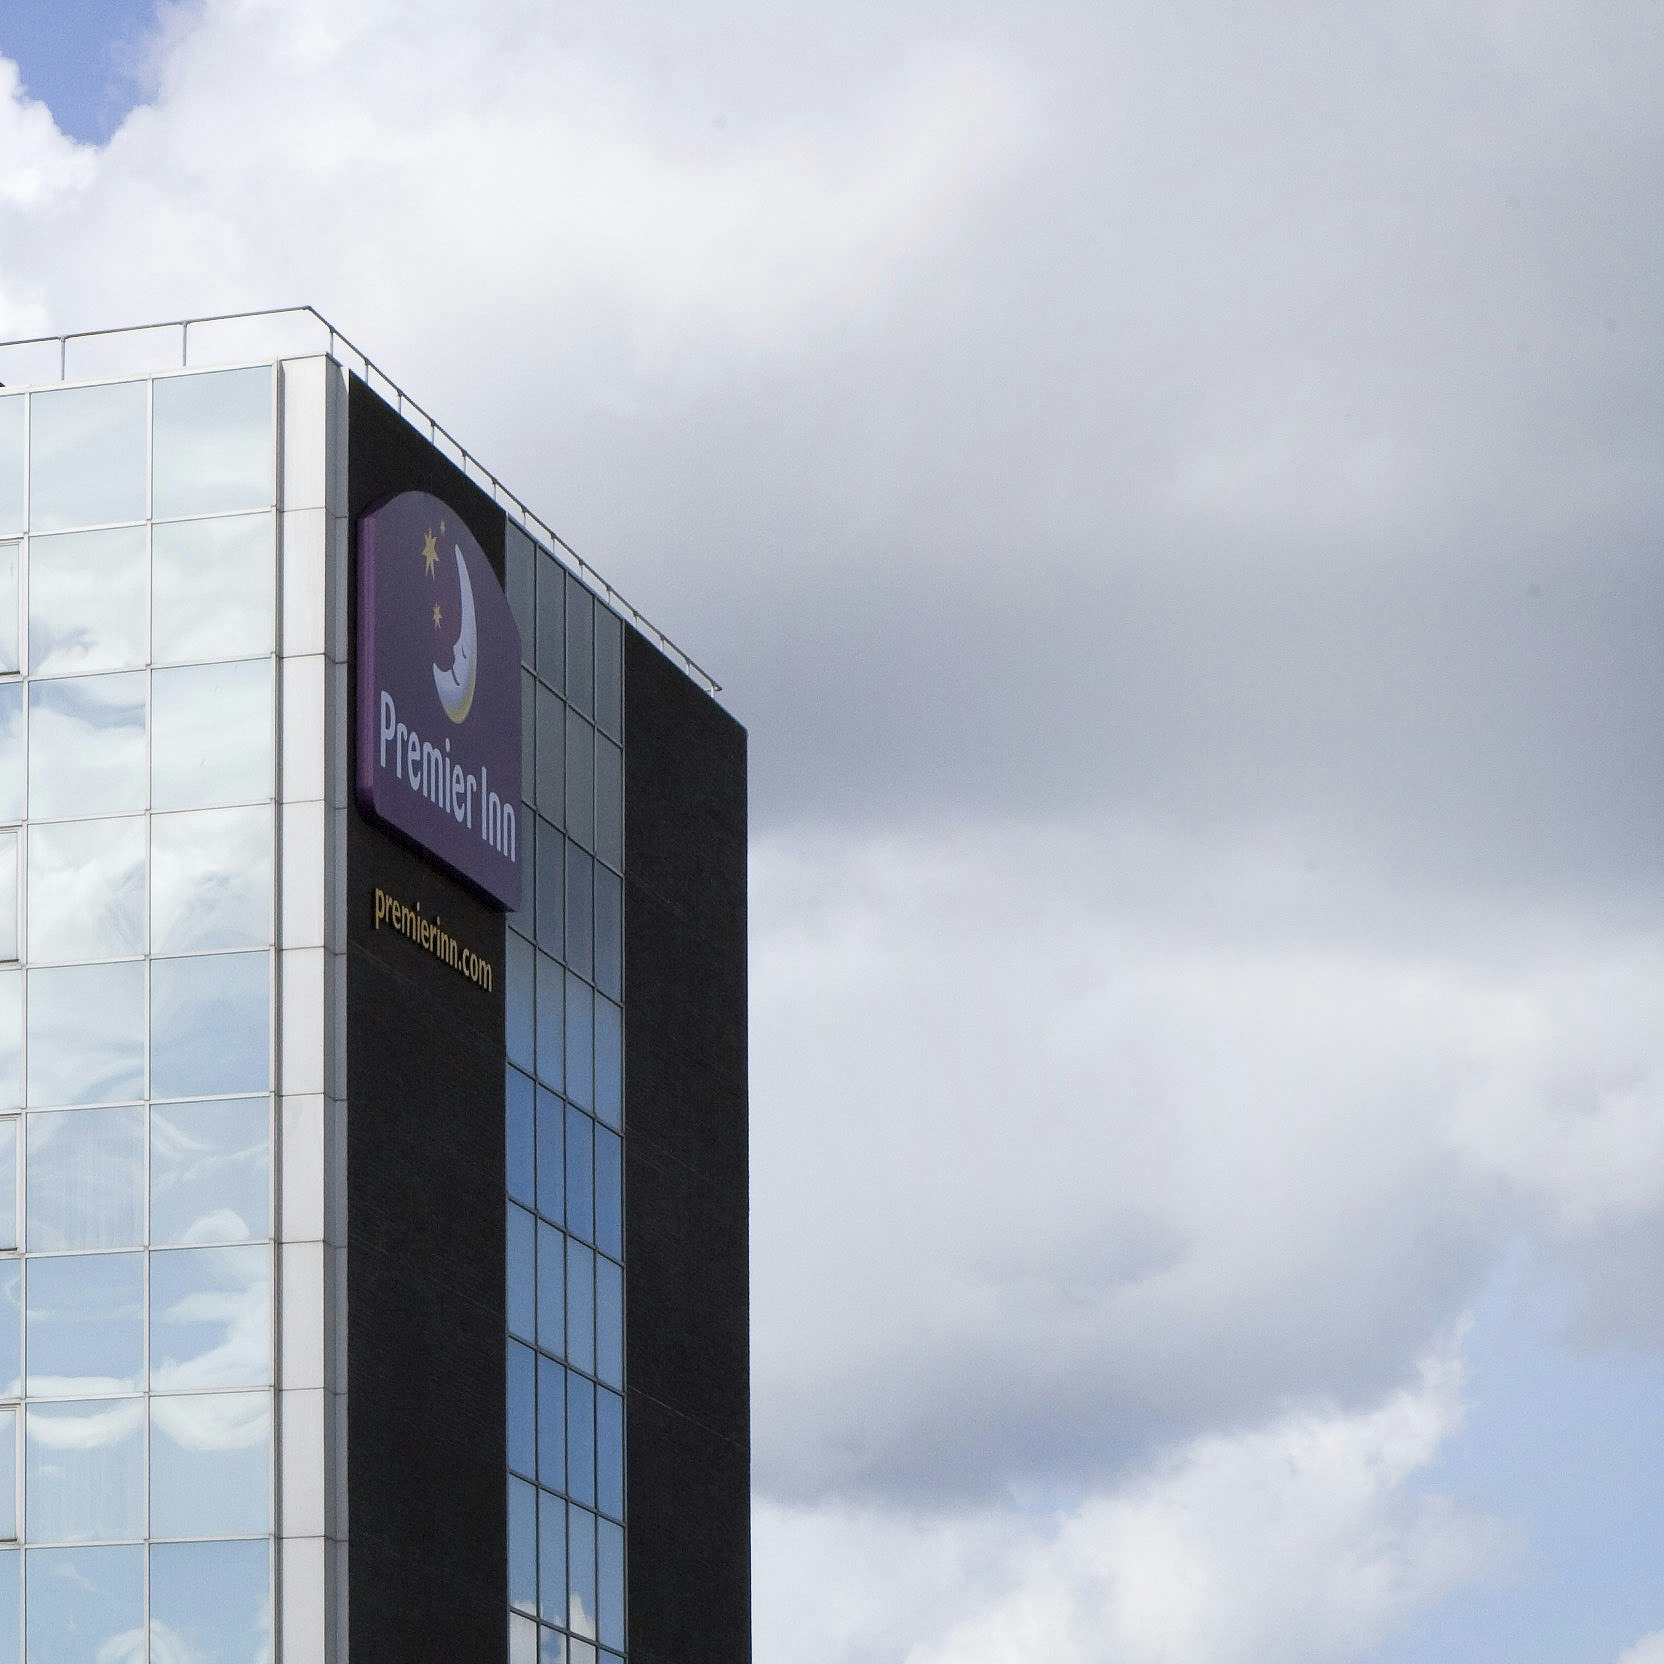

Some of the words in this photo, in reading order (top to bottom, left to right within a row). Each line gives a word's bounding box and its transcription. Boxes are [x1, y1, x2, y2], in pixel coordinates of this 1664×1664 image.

[379, 690, 477, 830] Premier
[480, 765, 517, 864] Inn
[374, 886, 493, 994] premierinn.com
